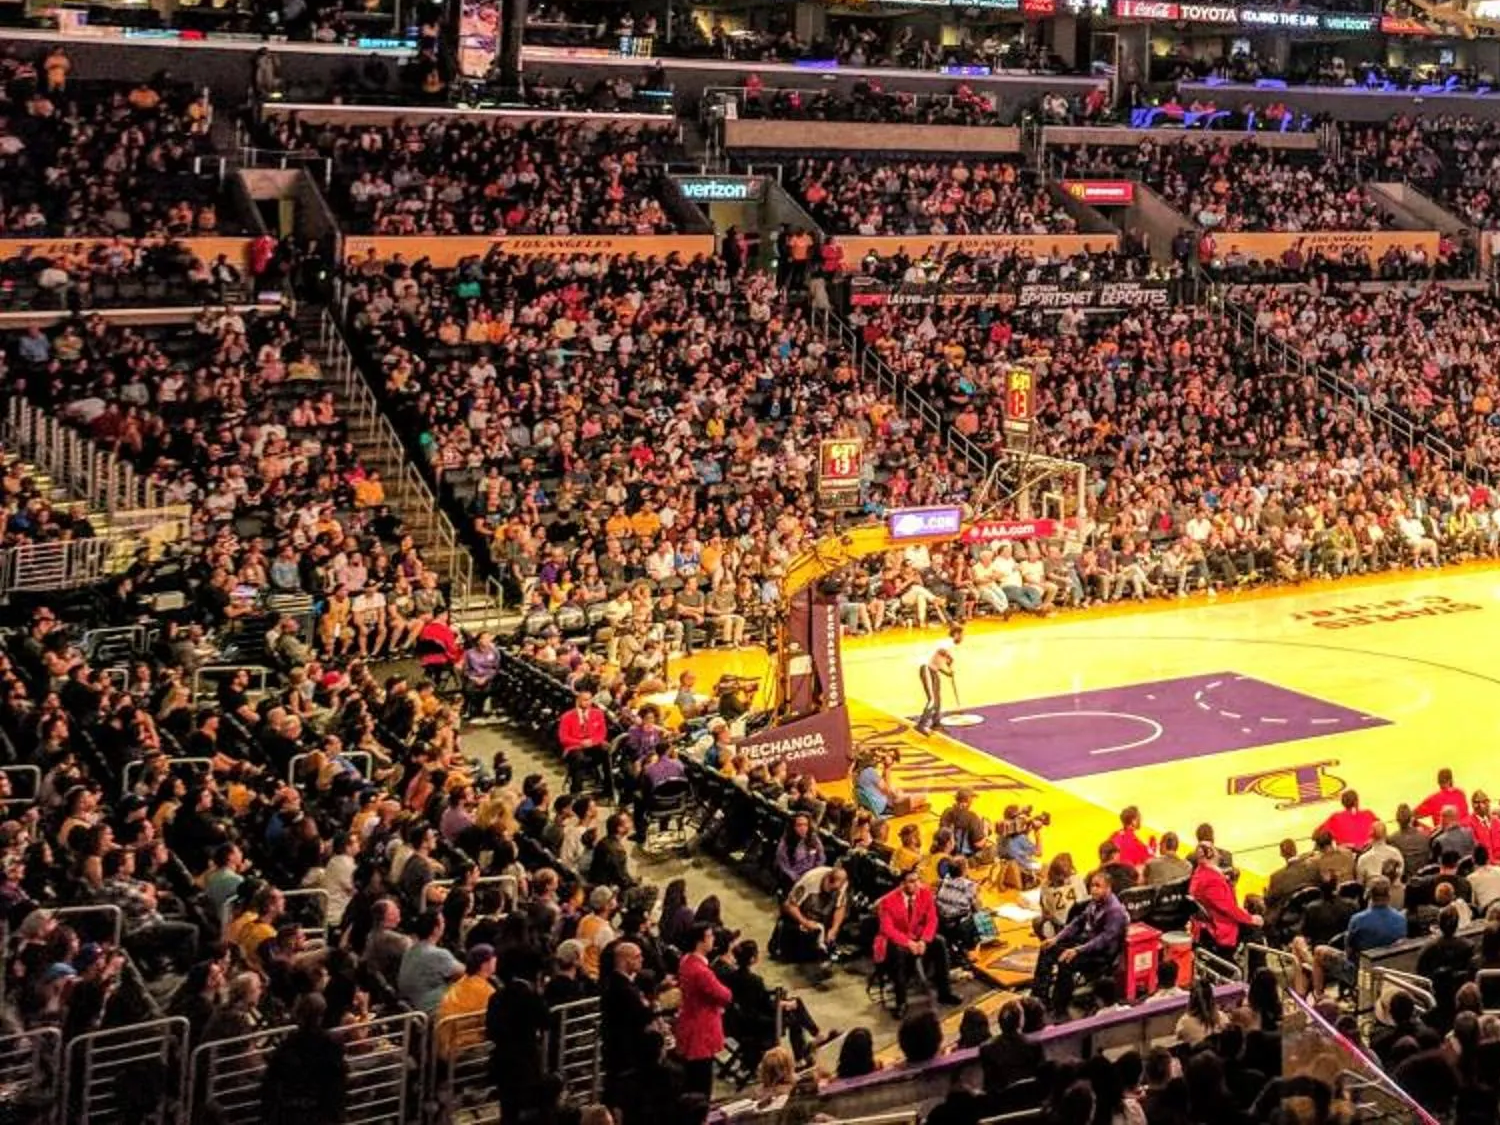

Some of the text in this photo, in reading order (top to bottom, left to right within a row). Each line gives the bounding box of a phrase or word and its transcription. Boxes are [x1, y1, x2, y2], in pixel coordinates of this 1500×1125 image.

[1180, 6, 1237, 22] TOYOTA
[1327, 18, 1370, 31] verizon
[683, 182, 747, 199] verizon
[1019, 290, 1094, 307] SPORTSNET
[1100, 288, 1168, 305] DEPORTES
[982, 525, 1036, 537] AAA.com
[741, 733, 824, 758] PECHANGA
